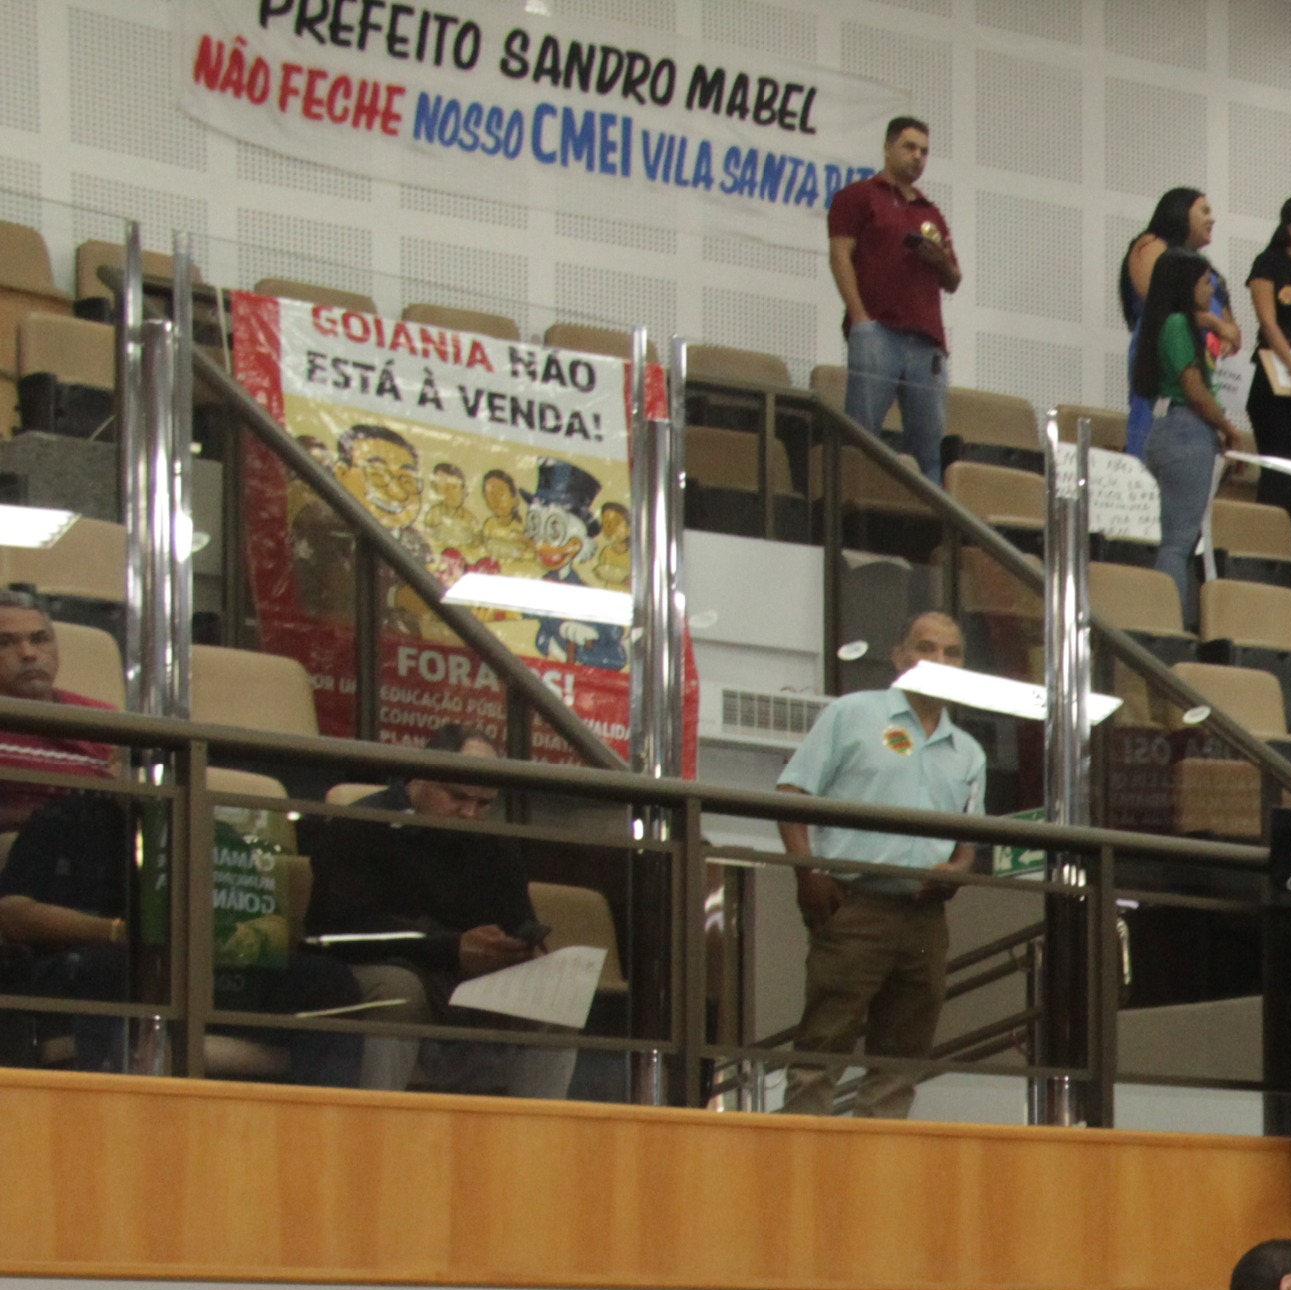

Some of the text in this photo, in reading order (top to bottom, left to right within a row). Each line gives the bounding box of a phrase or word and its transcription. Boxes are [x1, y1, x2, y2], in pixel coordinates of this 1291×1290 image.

[258, 0, 819, 135] PREFEITO SANDRO MABEL
[193, 33, 271, 106] NÃO
[278, 62, 407, 137] FECHE
[412, 91, 525, 161] NOSSO
[531, 103, 633, 178] CMEI
[641, 128, 715, 192] VILA
[719, 145, 820, 210] SANTA
[305, 350, 604, 443] ESTÁ À VENDA!
[379, 684, 463, 714] EDUCAÇÃO
[466, 695, 508, 720] PÚBL
[397, 645, 501, 692] FORA
